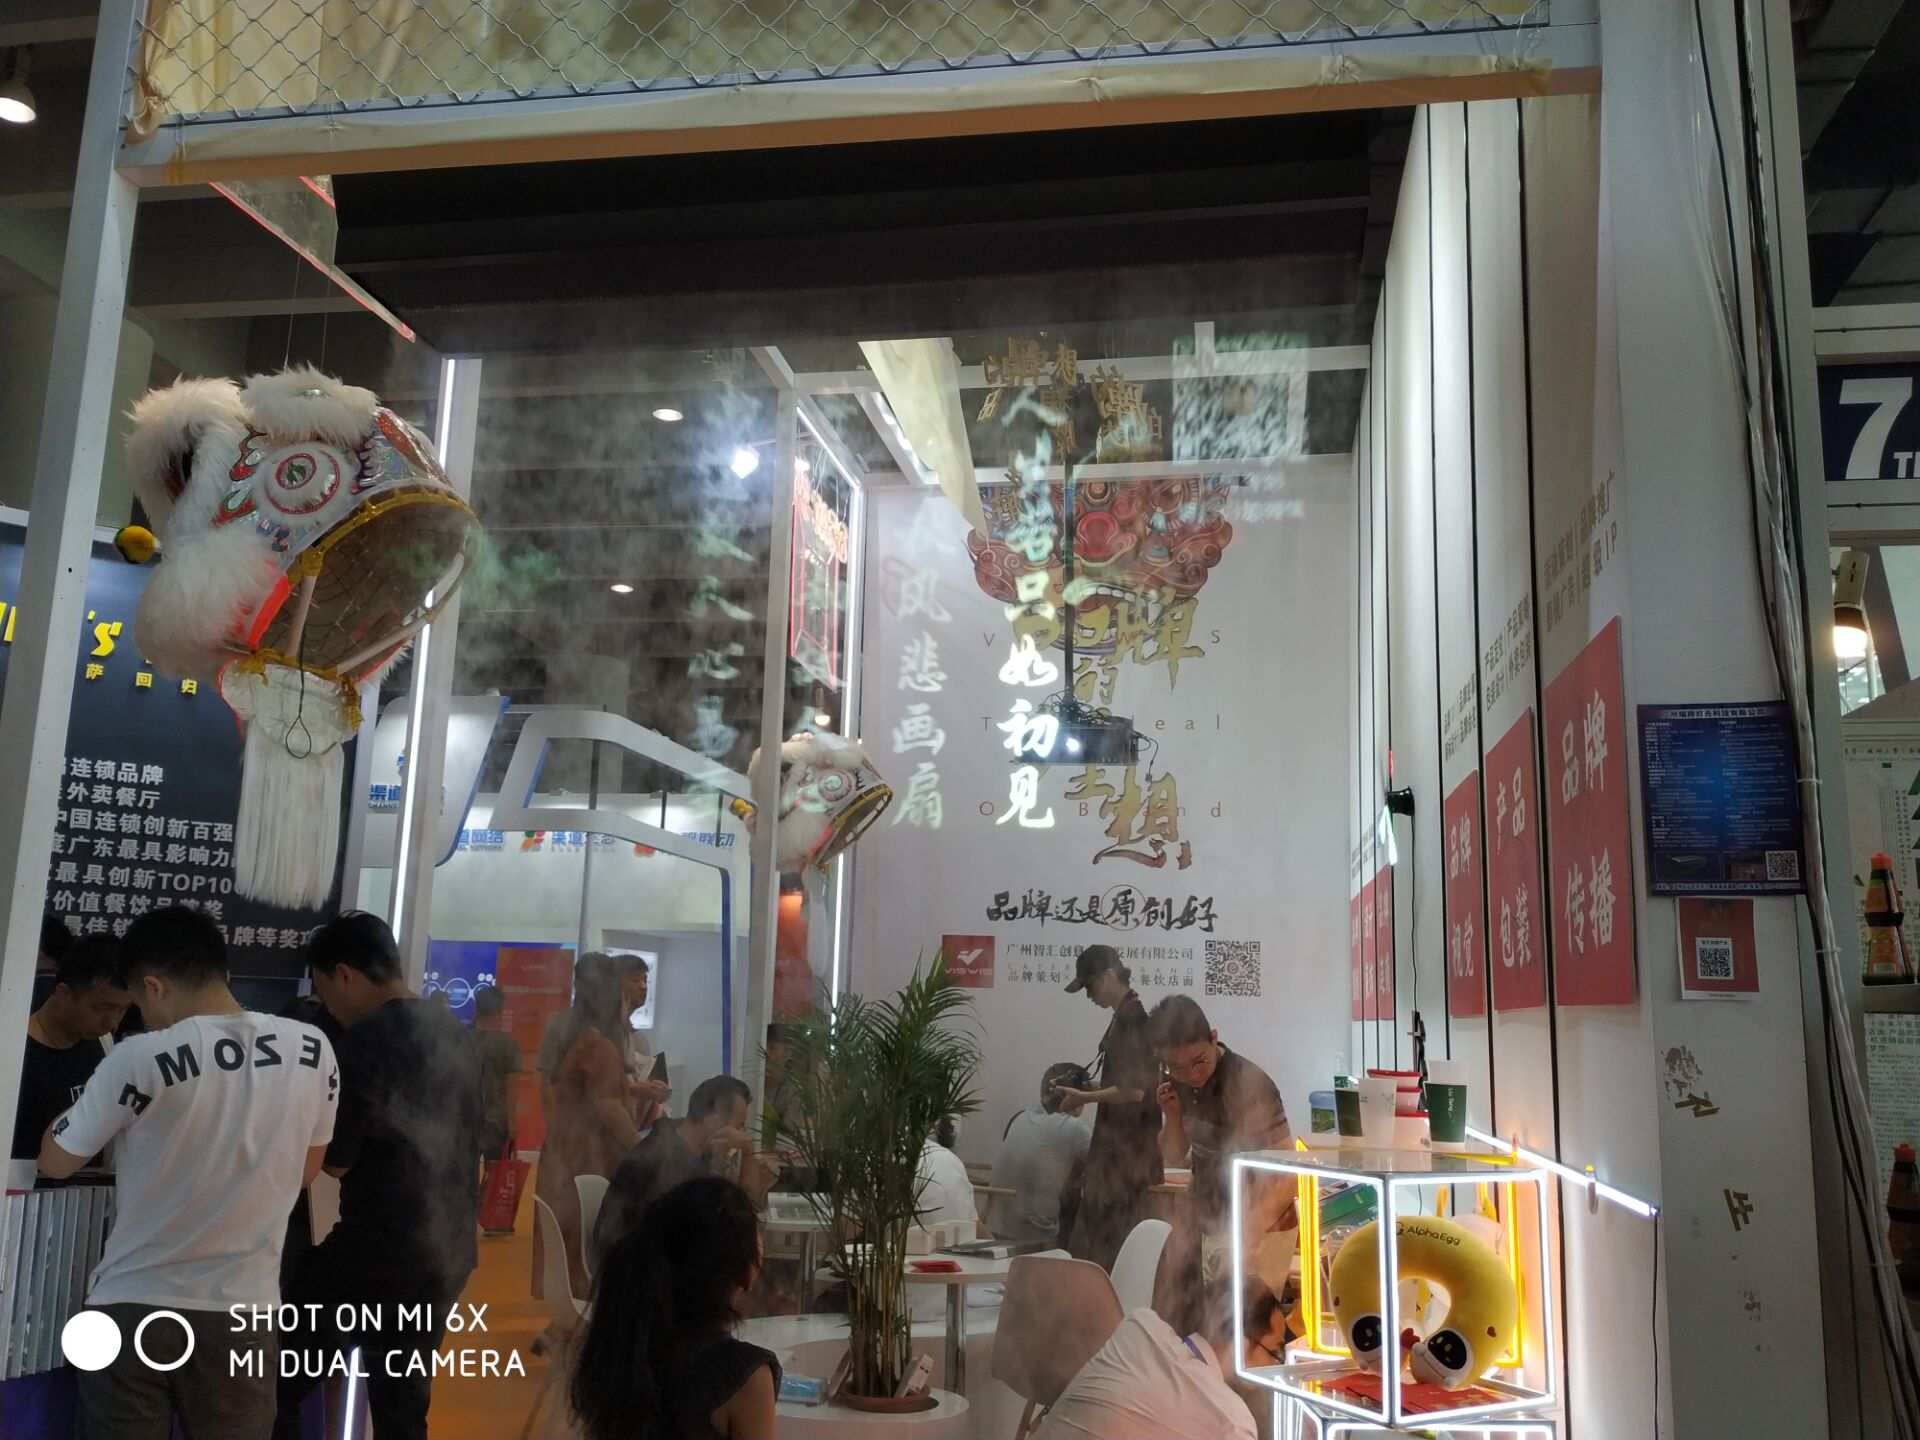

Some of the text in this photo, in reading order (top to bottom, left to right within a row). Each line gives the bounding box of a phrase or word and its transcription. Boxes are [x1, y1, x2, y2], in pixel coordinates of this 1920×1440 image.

[1561, 686, 1609, 807] 品牌
[60, 757, 164, 785] 连锁品牌
[57, 782, 160, 808] 外卖餐厅
[1495, 765, 1526, 856] 产品
[51, 832, 236, 868] 度广东最具影响力
[1449, 808, 1472, 880] 品牌
[47, 861, 242, 895] 最具创新TOP10
[986, 888, 1219, 932] 品牌还是原创好
[1563, 846, 1617, 957] 传播
[1499, 882, 1532, 968] 包装
[1006, 943, 1193, 961] 广州智汇创意发展有限公司
